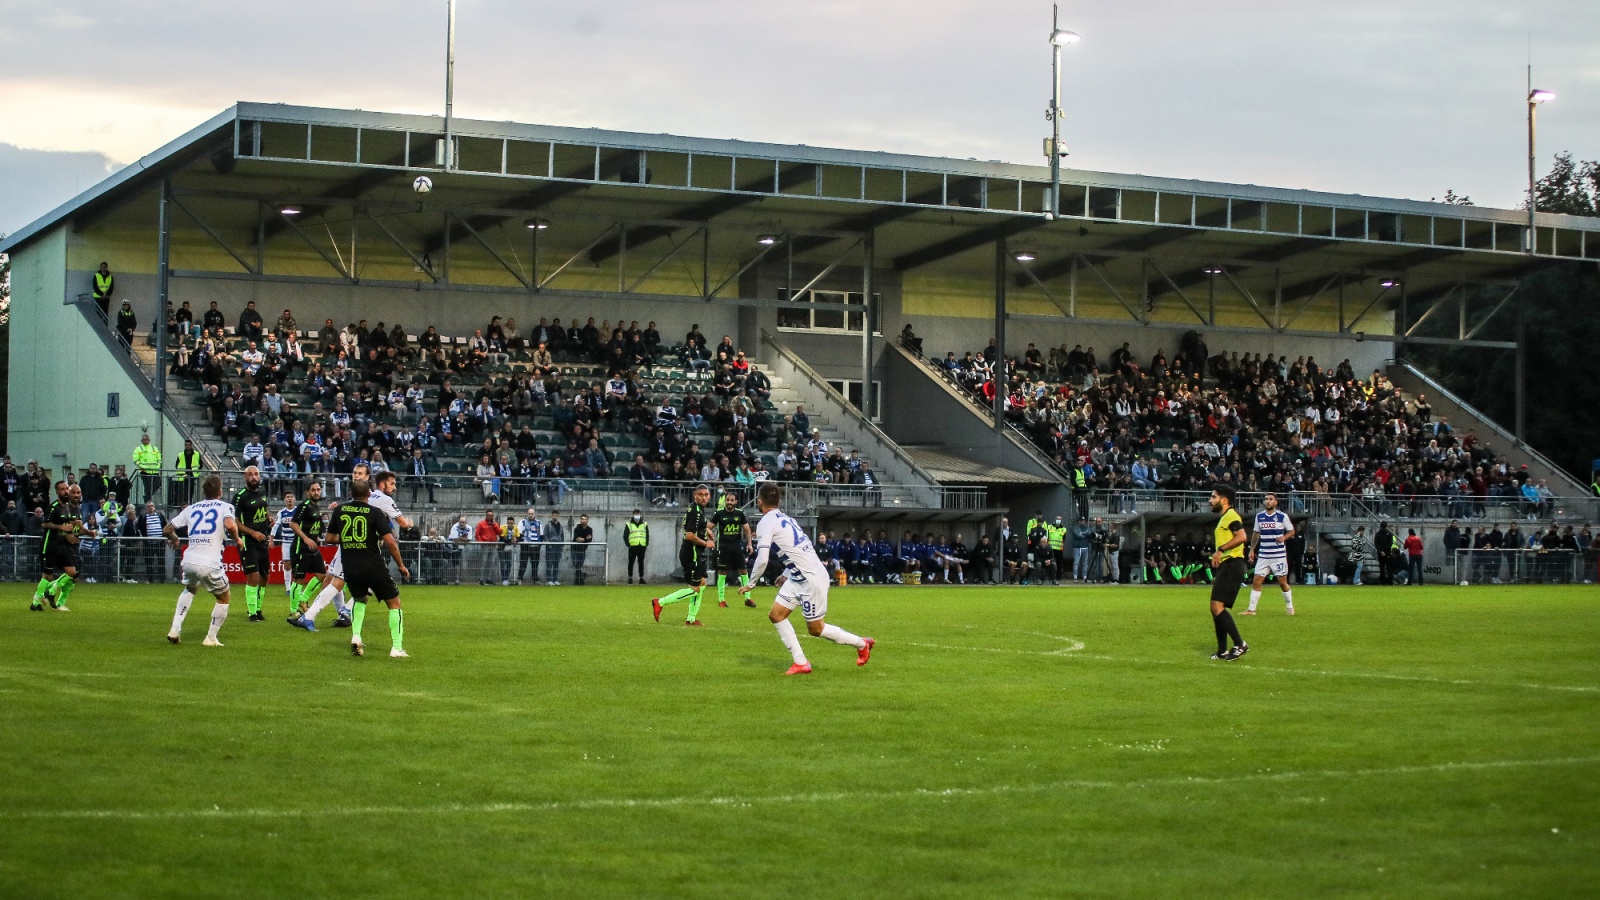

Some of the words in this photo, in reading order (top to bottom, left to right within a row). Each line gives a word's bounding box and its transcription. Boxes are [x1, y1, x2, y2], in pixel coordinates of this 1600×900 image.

[189, 508, 219, 537] 23
[340, 513, 368, 543] 20
[1276, 562, 1285, 573] 37
[1423, 565, 1442, 575] Jeep
